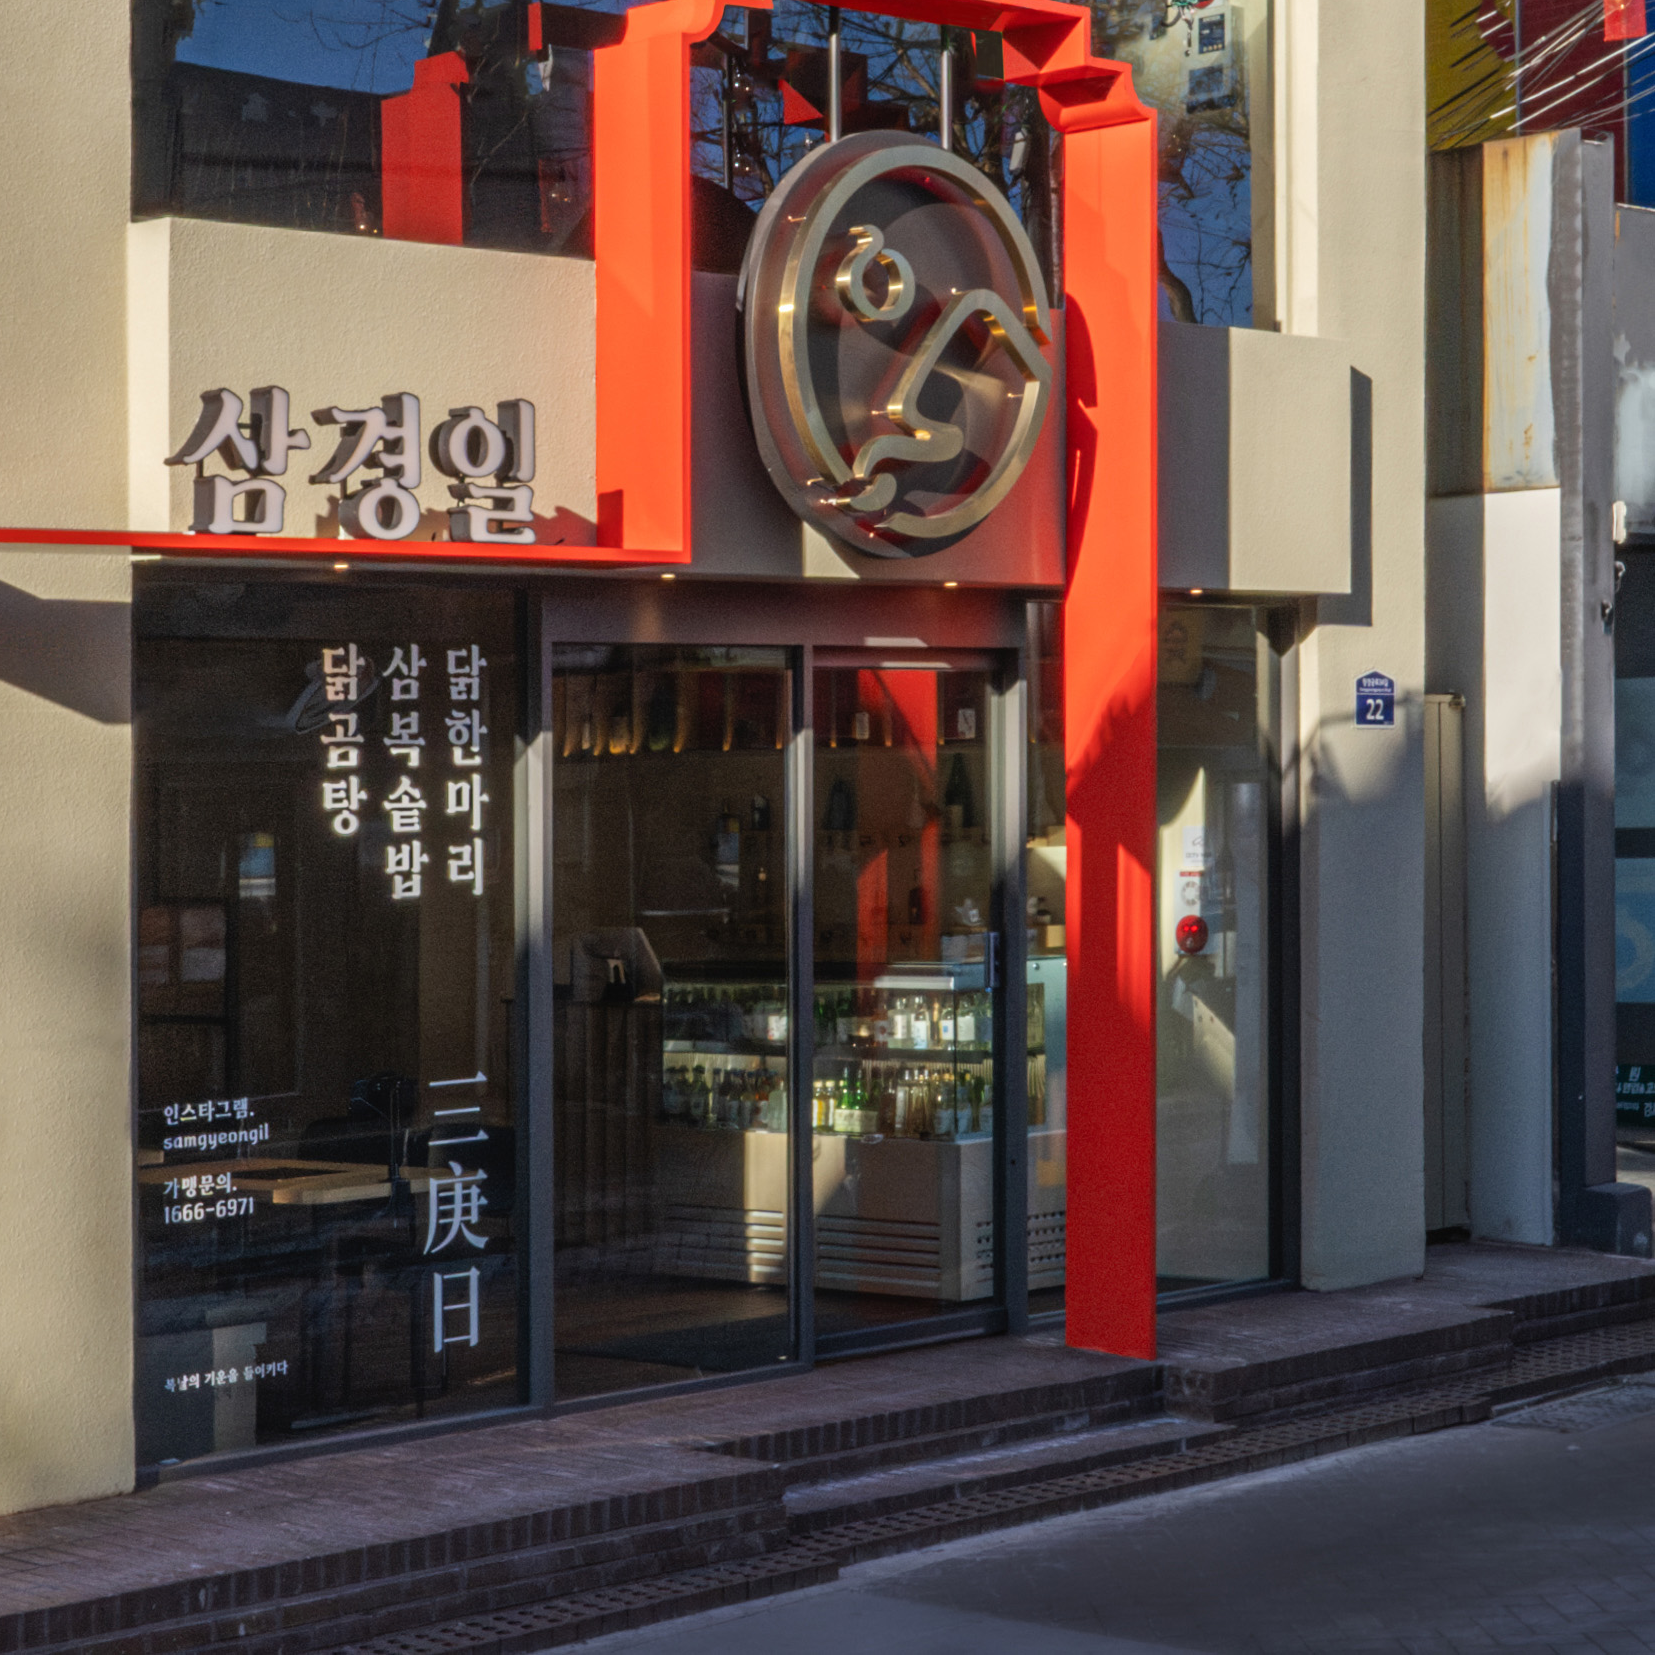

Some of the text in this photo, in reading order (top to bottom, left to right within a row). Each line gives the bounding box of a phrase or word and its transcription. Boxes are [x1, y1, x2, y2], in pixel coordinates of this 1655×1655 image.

[164, 386, 536, 544] 삼경일
[1366, 698, 1384, 720] 22
[320, 643, 368, 835] 닭곰탕
[383, 644, 429, 899] 삼복솥밥
[445, 644, 489, 896] 닭한마리
[164, 1098, 254, 1125] 인스타그램.
[163, 1123, 269, 1150] samgyeongil
[163, 1172, 237, 1199] 가맹문의.
[165, 1197, 254, 1224] 1666-6971
[423, 1070, 489, 1353] 三庚日
[204, 1367, 238, 1386] 기운을
[243, 1360, 288, 1381] 들이키다
